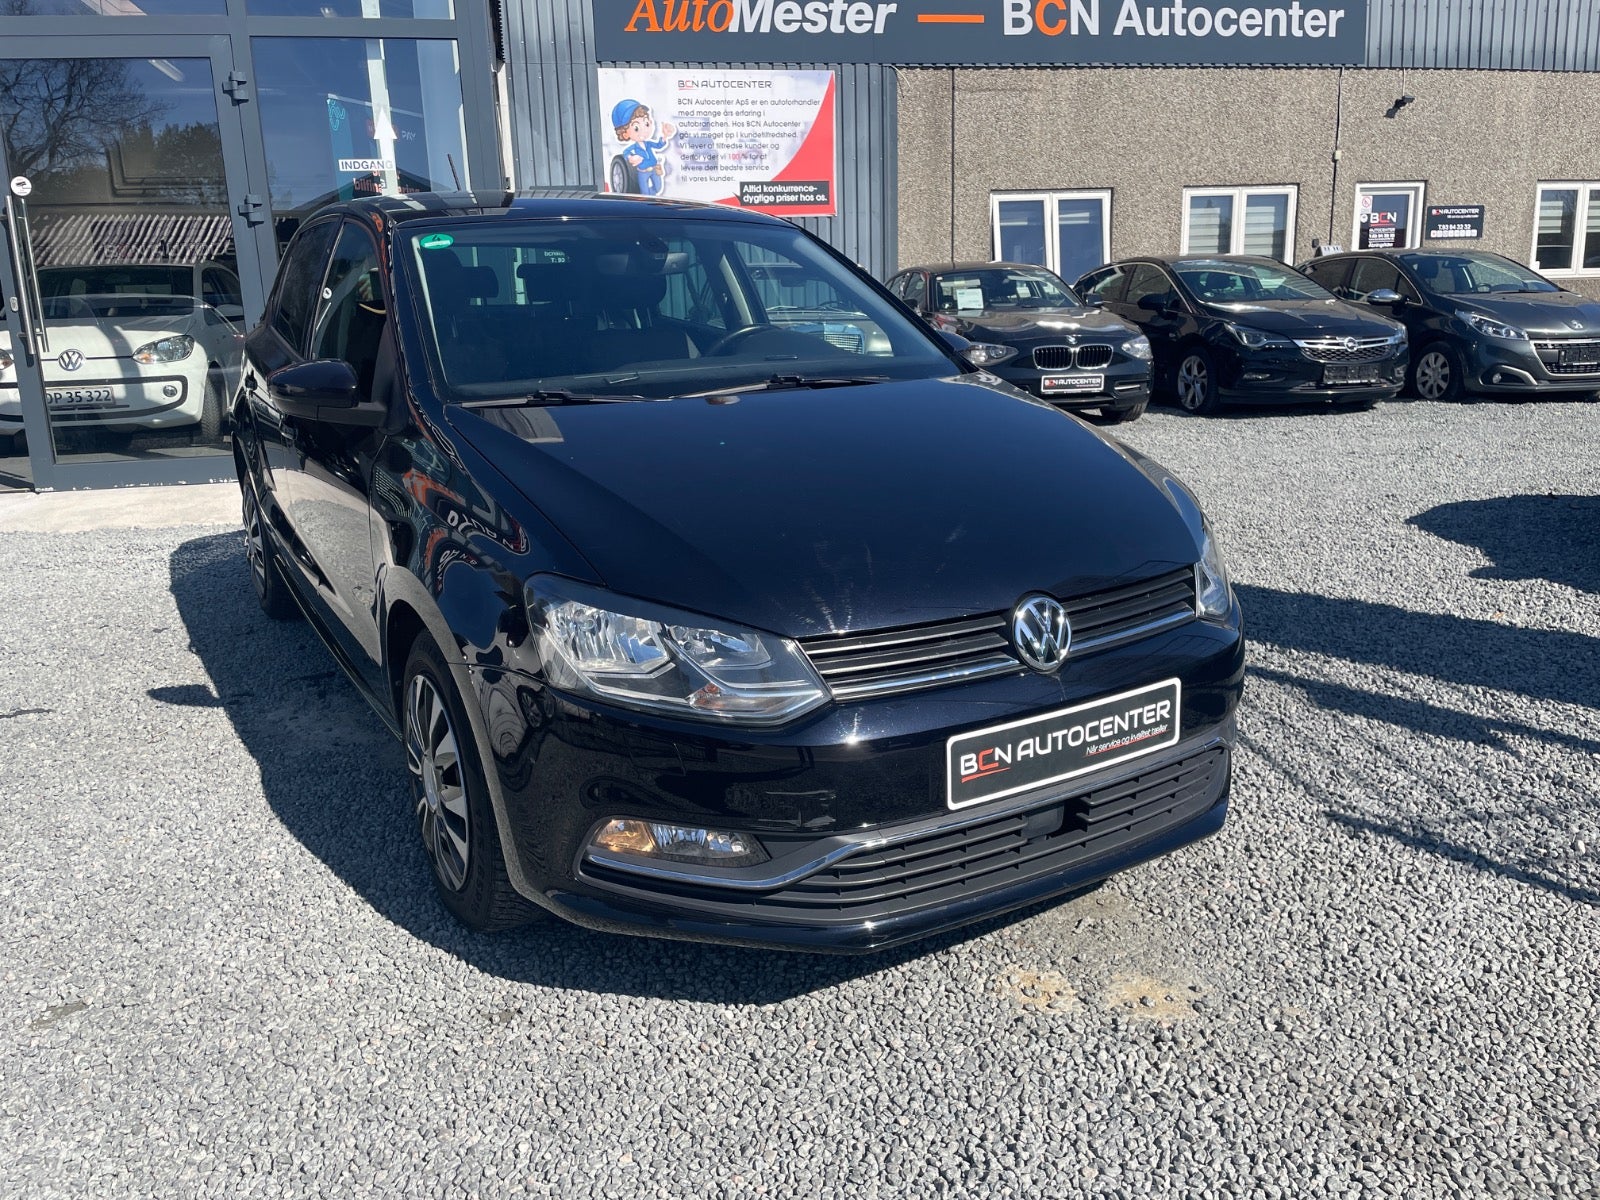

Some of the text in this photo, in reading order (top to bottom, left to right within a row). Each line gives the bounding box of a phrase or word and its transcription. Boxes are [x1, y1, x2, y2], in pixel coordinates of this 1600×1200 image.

[624, 0, 1345, 37] AutoMester BCN Autocenter
[678, 80, 772, 89] BCN AUTOCENTER
[735, 98, 749, 106] ApS
[696, 110, 721, 118] mange
[735, 110, 761, 118] erfaring
[341, 160, 394, 170] INDGANG
[742, 184, 818, 193] Altid konkurrence-
[743, 194, 775, 204] dygtige
[775, 194, 799, 203] priser
[799, 194, 815, 202] hos
[1370, 211, 1397, 223] BCN
[65, 391, 83, 403] 35
[85, 389, 112, 402] 322
[960, 699, 1171, 776] BCN AUTOCENTER
[1086, 744, 1100, 756] Når
[1098, 737, 1121, 752] service
[1121, 735, 1130, 745] og
[1130, 728, 1151, 743] kvalitet
